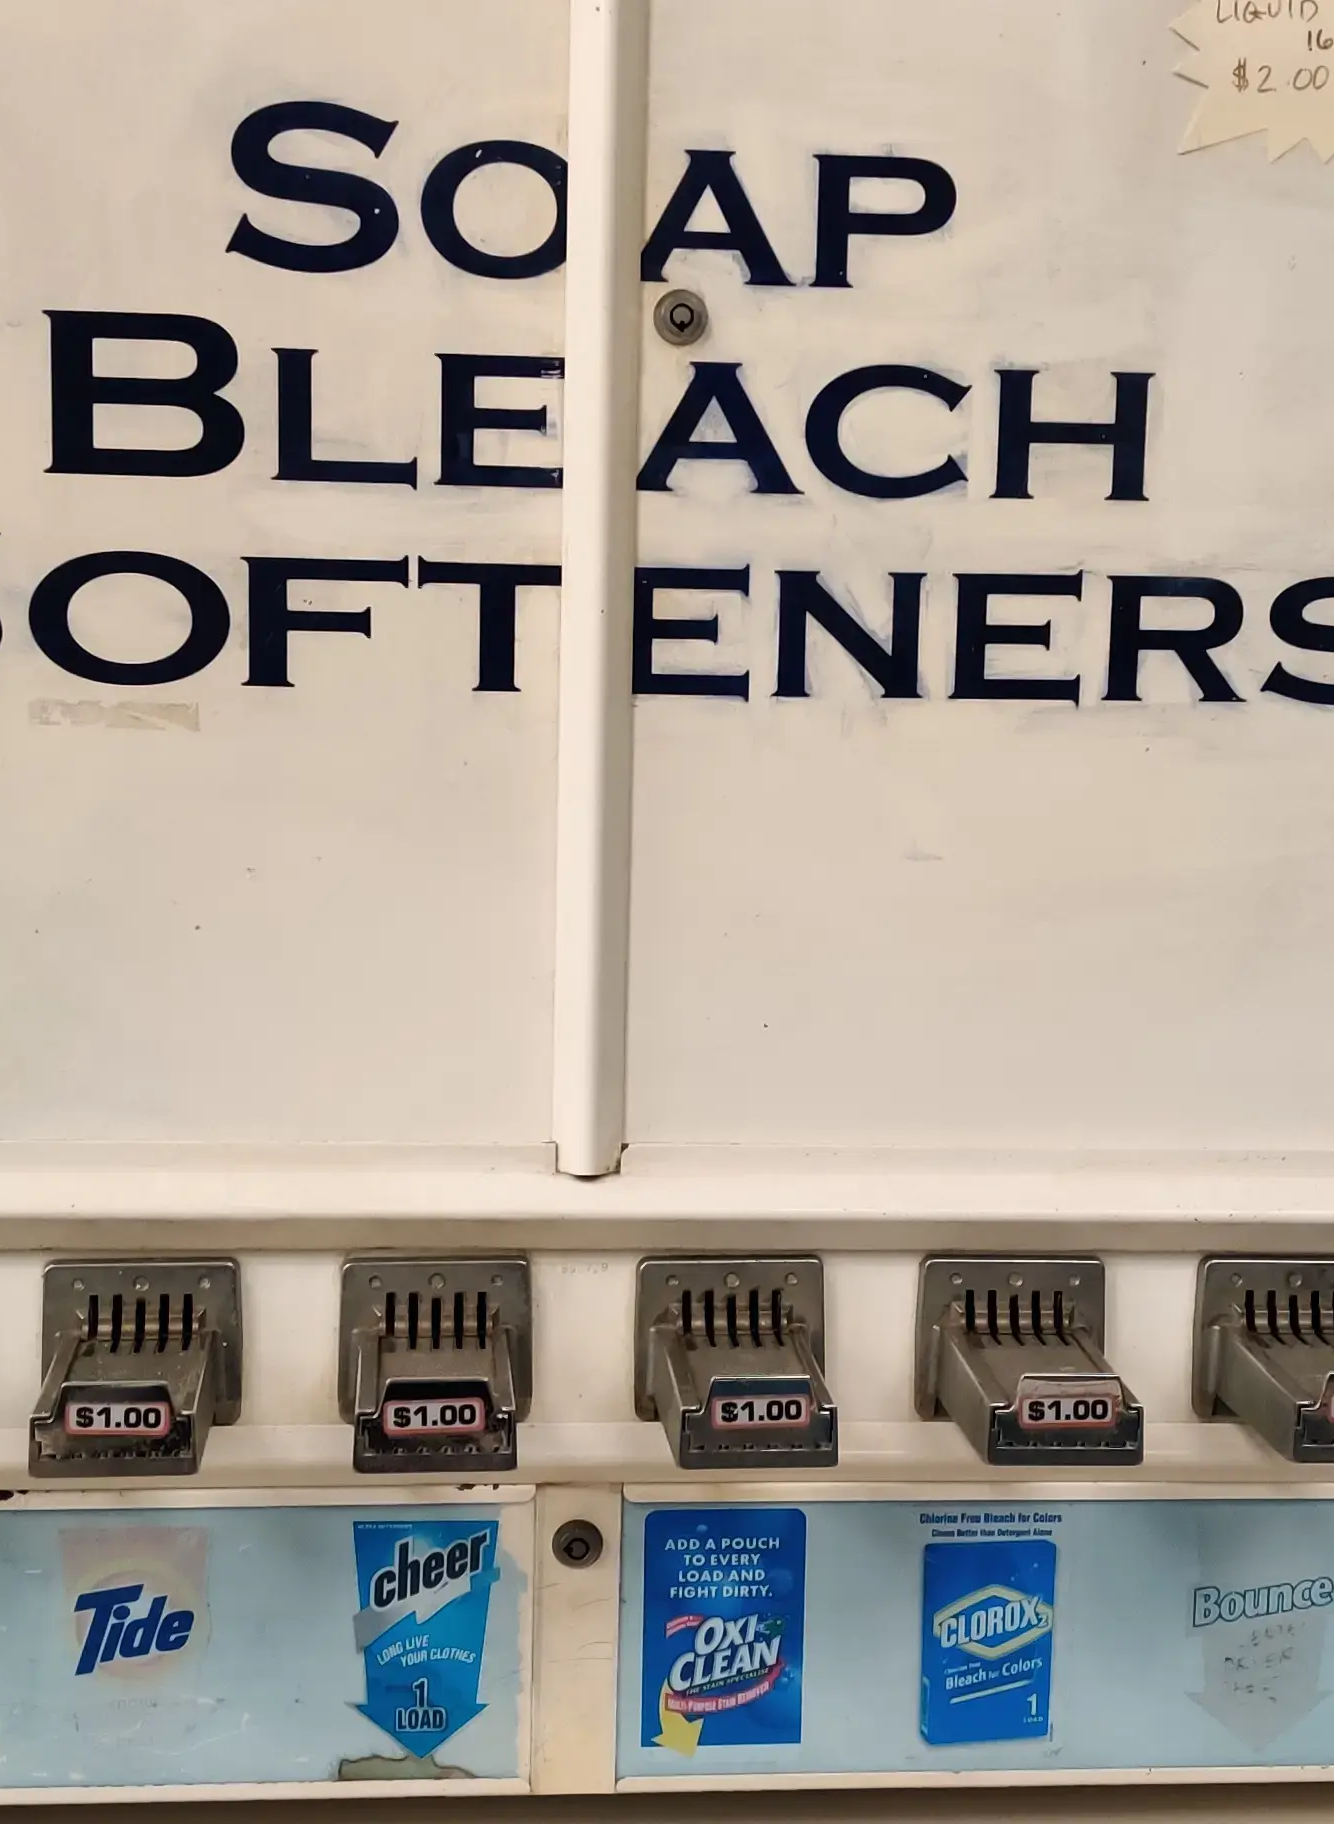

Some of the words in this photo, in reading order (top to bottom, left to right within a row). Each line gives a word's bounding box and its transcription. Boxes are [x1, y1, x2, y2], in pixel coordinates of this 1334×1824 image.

[1216, 0, 1319, 23] LIQUID
[226, 100, 958, 289] SOAP
[41, 309, 1157, 502] BLEACH
[75, 1405, 163, 1430] $1.00
[392, 1403, 477, 1428] $1.00
[720, 1399, 803, 1423] $1.00
[1027, 1398, 1109, 1422] $1.00
[919, 1512, 958, 1525] Chlorine
[983, 1511, 1015, 1524] Bleach
[1017, 1512, 1030, 1523] for
[1032, 1512, 1063, 1523] Colors
[665, 1538, 700, 1550] ADD
[704, 1538, 716, 1550] A
[721, 1537, 780, 1550] POUCH
[372, 1530, 489, 1609] cheer
[683, 1554, 705, 1566] TO
[710, 1553, 761, 1566] EVERY
[678, 1570, 723, 1582] LOAD
[727, 1569, 766, 1582] AND
[669, 1586, 718, 1598] FIGHT
[722, 1584, 773, 1598] DIRTY.
[1192, 1576, 1334, 1628] Bounce
[74, 1583, 195, 1676] Tide
[694, 1613, 759, 1656] OXI
[376, 1641, 404, 1666] LONG
[405, 1634, 429, 1650] LIVE
[400, 1650, 427, 1667] YOUR
[430, 1647, 476, 1664] CLOTHES
[669, 1635, 782, 1692] CLEAN
[945, 1667, 986, 1690] Bleach
[1002, 1657, 1043, 1677] Colors
[412, 1677, 428, 1708] 1
[702, 1680, 725, 1691] STAIN
[1026, 1693, 1038, 1716] 1
[395, 1706, 446, 1732] LOAD
